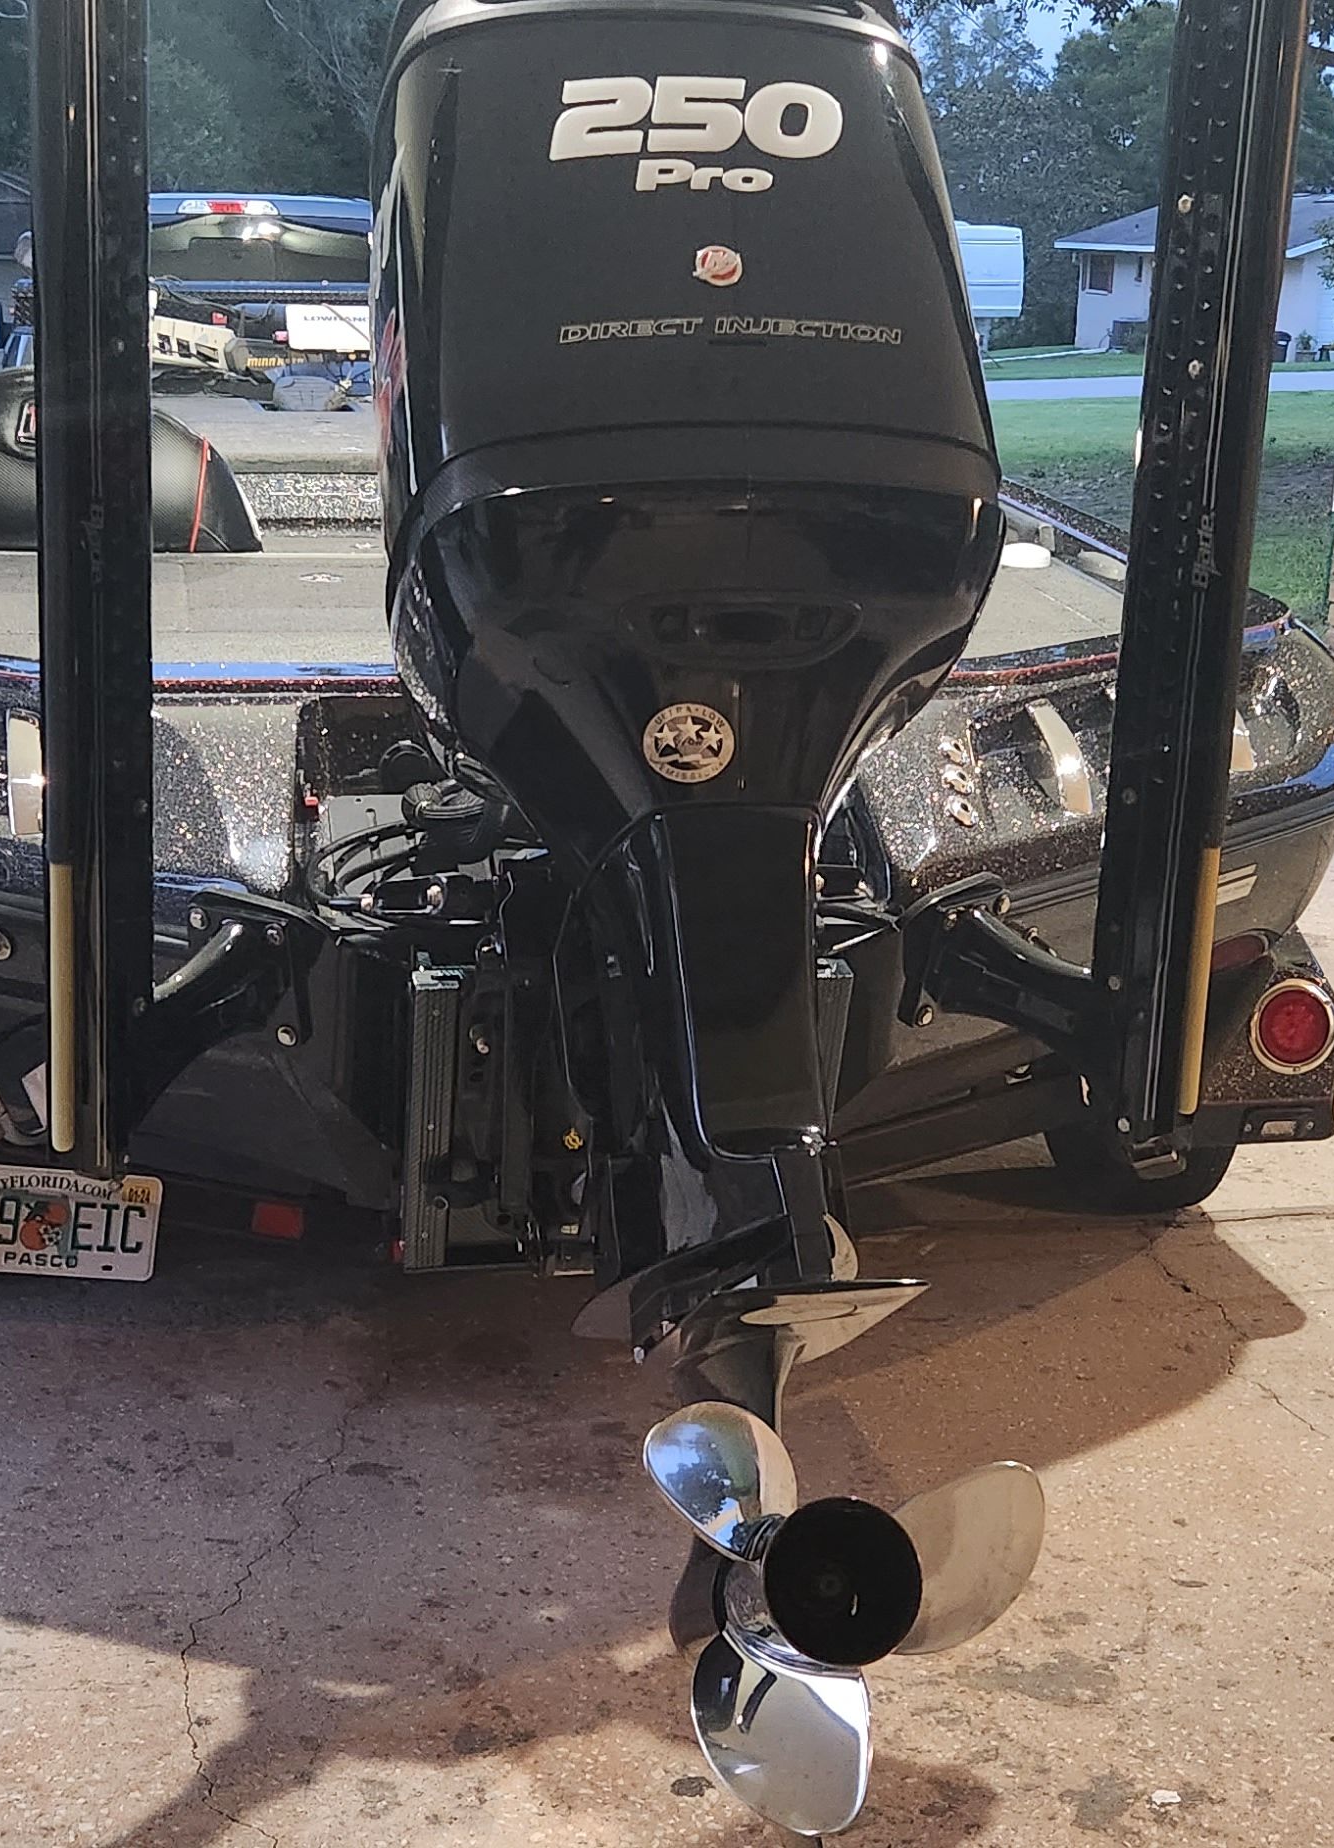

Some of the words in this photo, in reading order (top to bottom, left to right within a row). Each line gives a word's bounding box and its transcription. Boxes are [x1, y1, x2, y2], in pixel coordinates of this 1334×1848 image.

[549, 76, 844, 161] 250
[635, 159, 774, 193] Pro
[559, 317, 703, 345] DIRECT
[714, 316, 902, 346] INJECTION
[1191, 511, 1222, 589] Blade
[70, 1201, 147, 1255] EIC
[3, 1250, 79, 1269] PASCO
